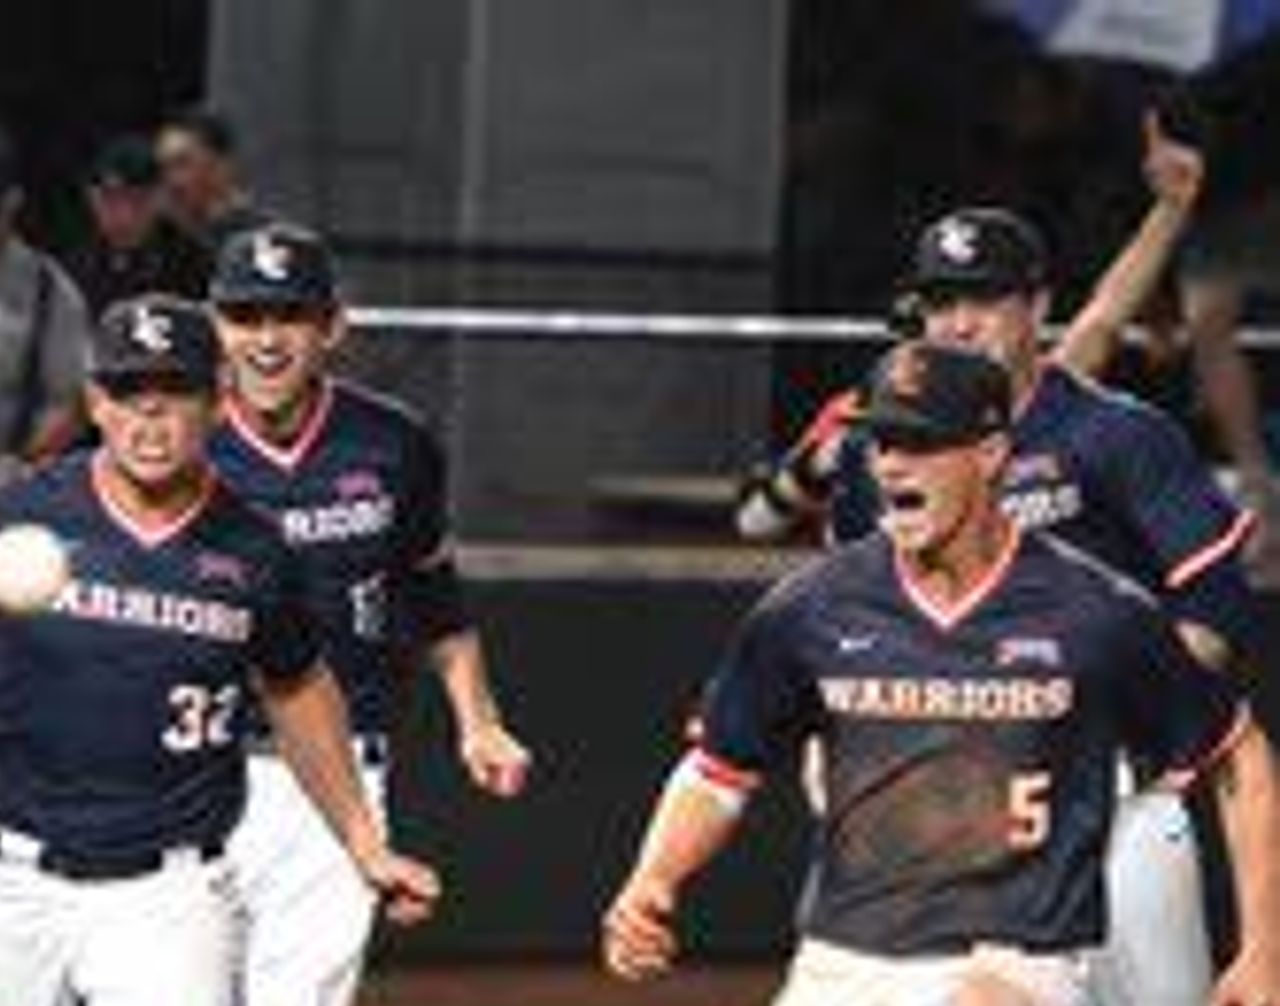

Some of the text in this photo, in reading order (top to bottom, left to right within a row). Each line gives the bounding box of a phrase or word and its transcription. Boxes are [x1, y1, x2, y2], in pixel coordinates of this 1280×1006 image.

[52, 579, 251, 642] ARRIORS
[816, 677, 1074, 720] WARRIORS
[1005, 770, 1053, 851] 5
